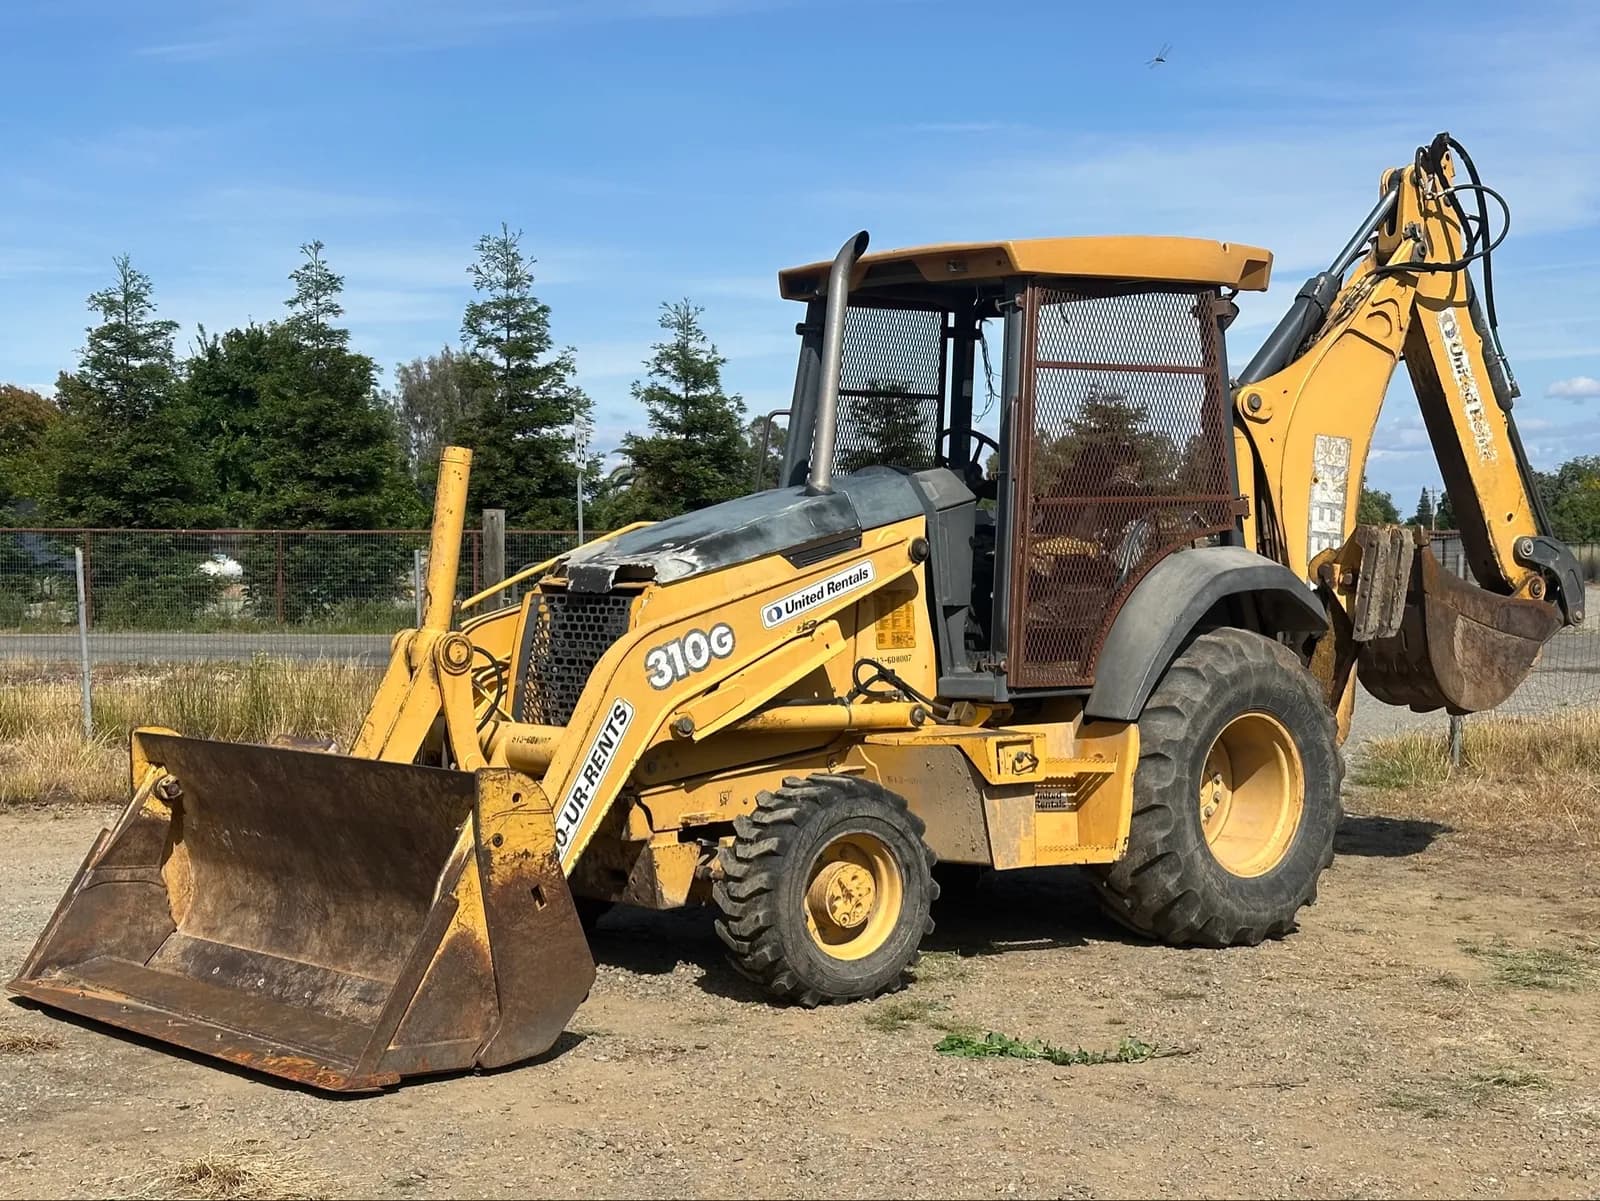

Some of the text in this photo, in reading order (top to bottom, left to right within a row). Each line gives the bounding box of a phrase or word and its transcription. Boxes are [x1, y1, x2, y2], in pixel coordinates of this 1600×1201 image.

[577, 442, 586, 464] 35
[785, 569, 869, 614] United Rentals
[644, 622, 736, 691] 310G
